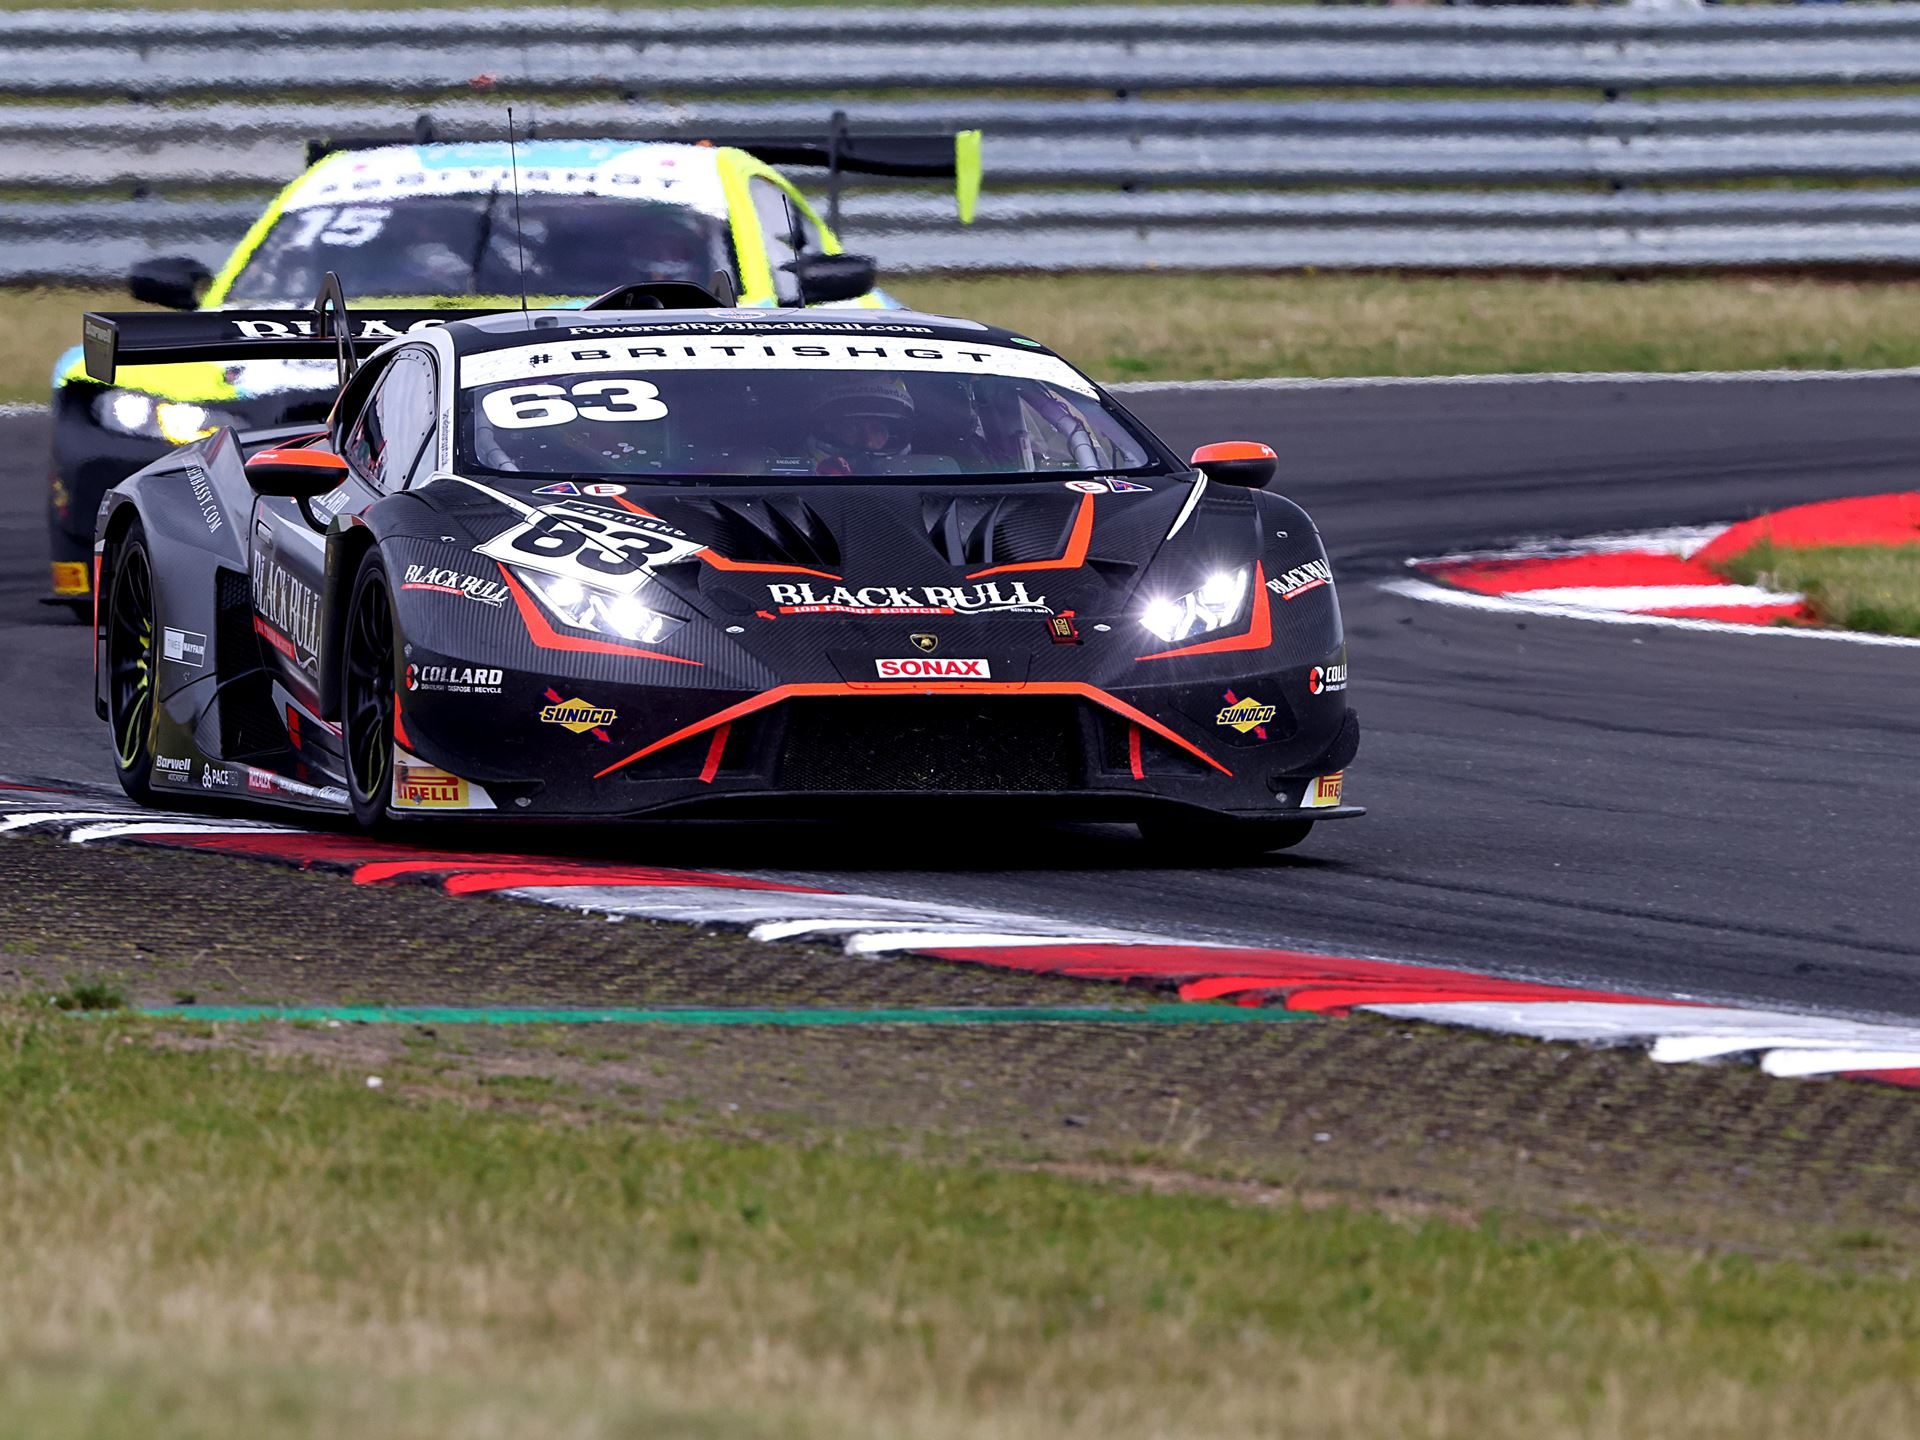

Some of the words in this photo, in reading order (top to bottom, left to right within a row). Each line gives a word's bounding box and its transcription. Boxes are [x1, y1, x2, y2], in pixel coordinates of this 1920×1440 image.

[291, 206, 393, 248] 15
[529, 345, 991, 365] #BRITISHGT
[482, 379, 668, 429] 63
[511, 513, 673, 576] 63
[404, 564, 464, 589] BLACK
[459, 575, 510, 603] BULL
[1265, 566, 1316, 595] BLACK
[253, 549, 289, 632] BLACK
[289, 576, 321, 658] BULL
[766, 582, 924, 608] BLACK
[921, 581, 1047, 608] BULL
[793, 605, 820, 613] 100
[824, 605, 876, 614] PROOF
[421, 665, 503, 685] COLLARD
[880, 660, 984, 677] SONAX
[474, 686, 502, 694] RECYCLE
[544, 706, 615, 724] SUNOCO
[1218, 705, 1274, 723] SUNOCO
[156, 755, 191, 771] Barwell
[396, 775, 459, 801] PIRELLI
